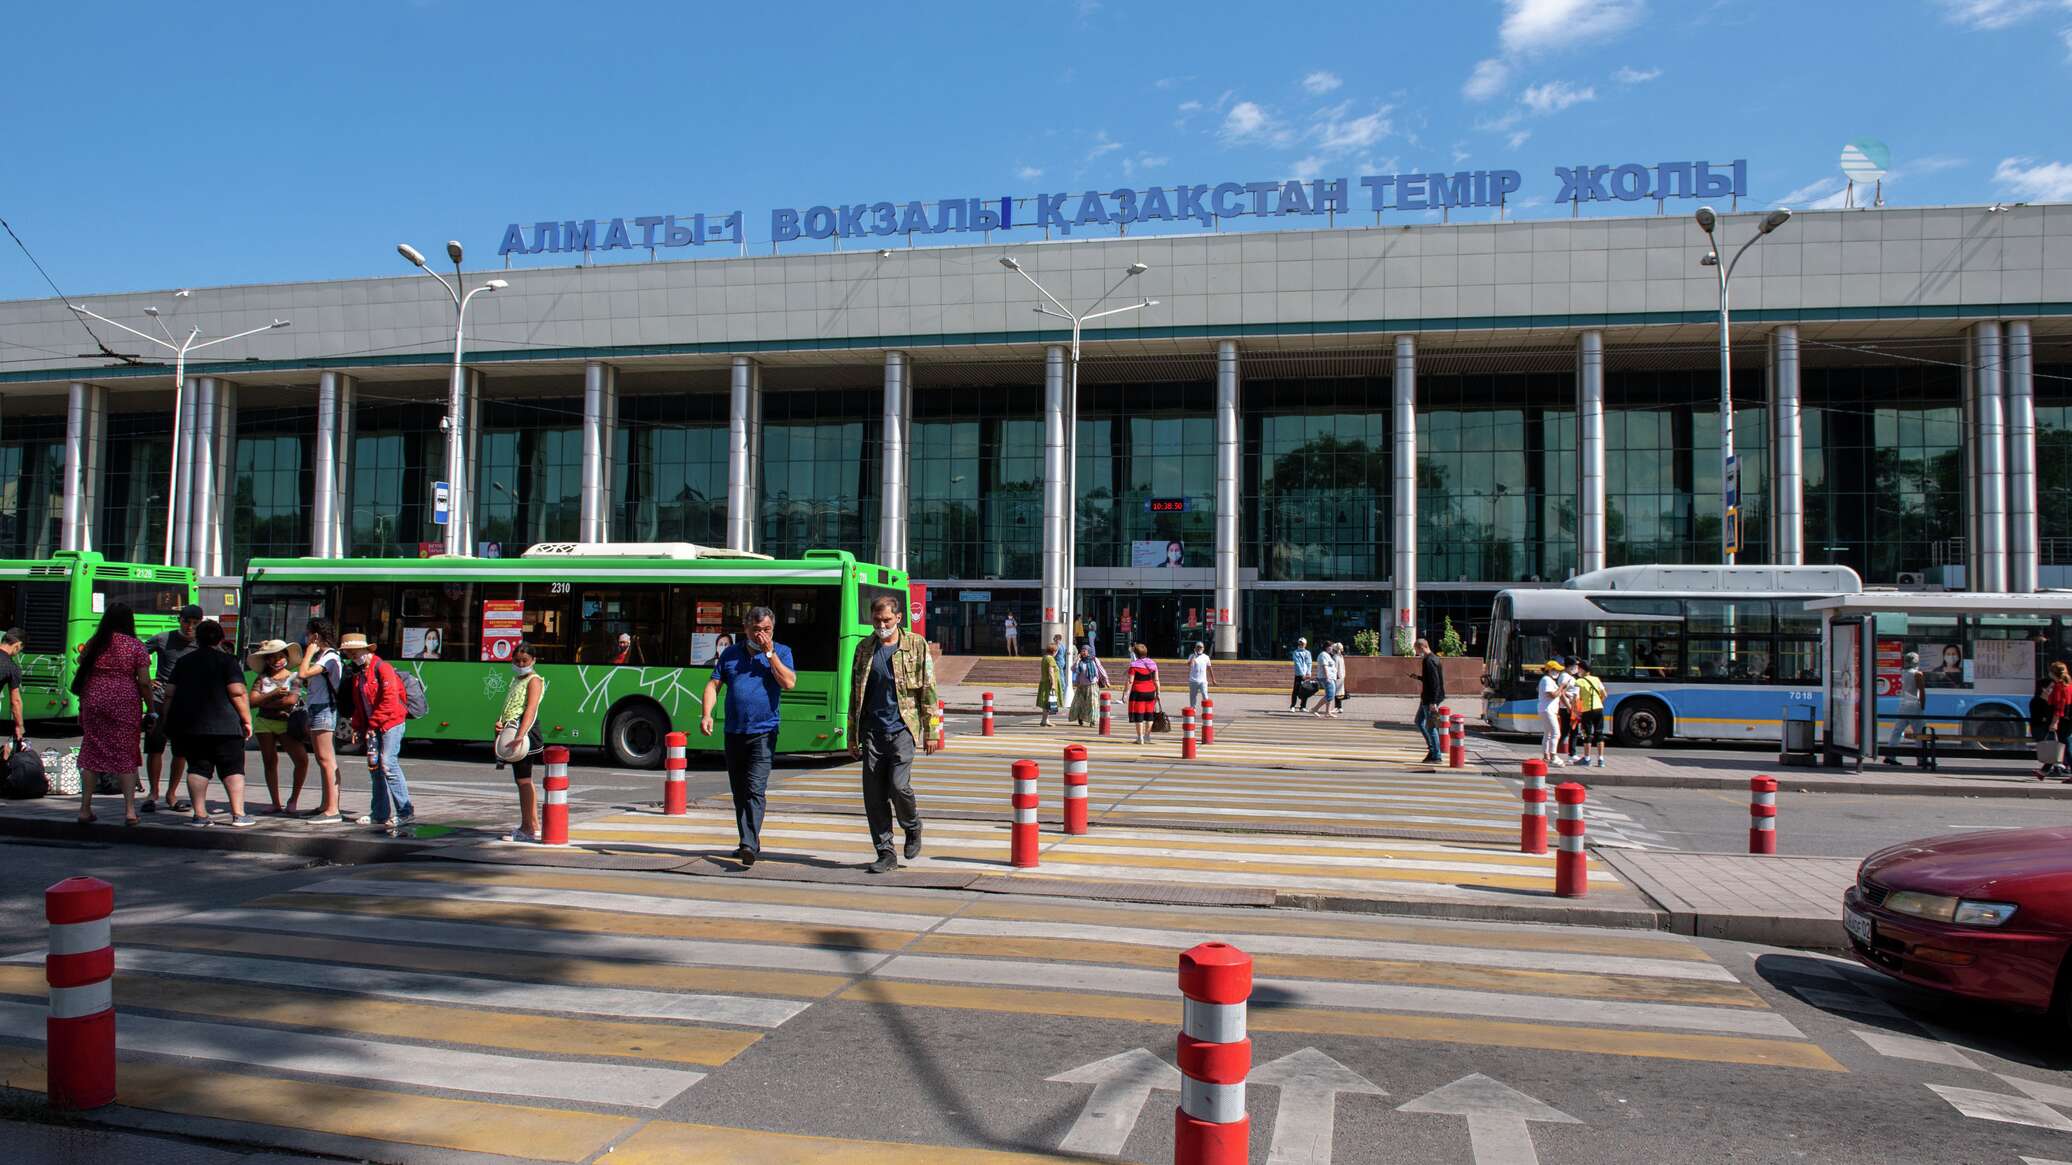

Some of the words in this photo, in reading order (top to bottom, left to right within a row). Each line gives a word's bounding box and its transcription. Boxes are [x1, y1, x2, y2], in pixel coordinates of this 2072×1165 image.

[498, 210, 743, 255] АЛМАТЫ-1
[771, 196, 1012, 241] ВОКЗАЛЫ
[1037, 177, 1350, 235] ҚАЗАҚСТАН
[1360, 169, 1522, 211] ТЕМІР
[1554, 159, 1747, 204] ЖОЛЫ
[551, 582, 571, 593] 2310
[1789, 691, 1813, 700] 7018
